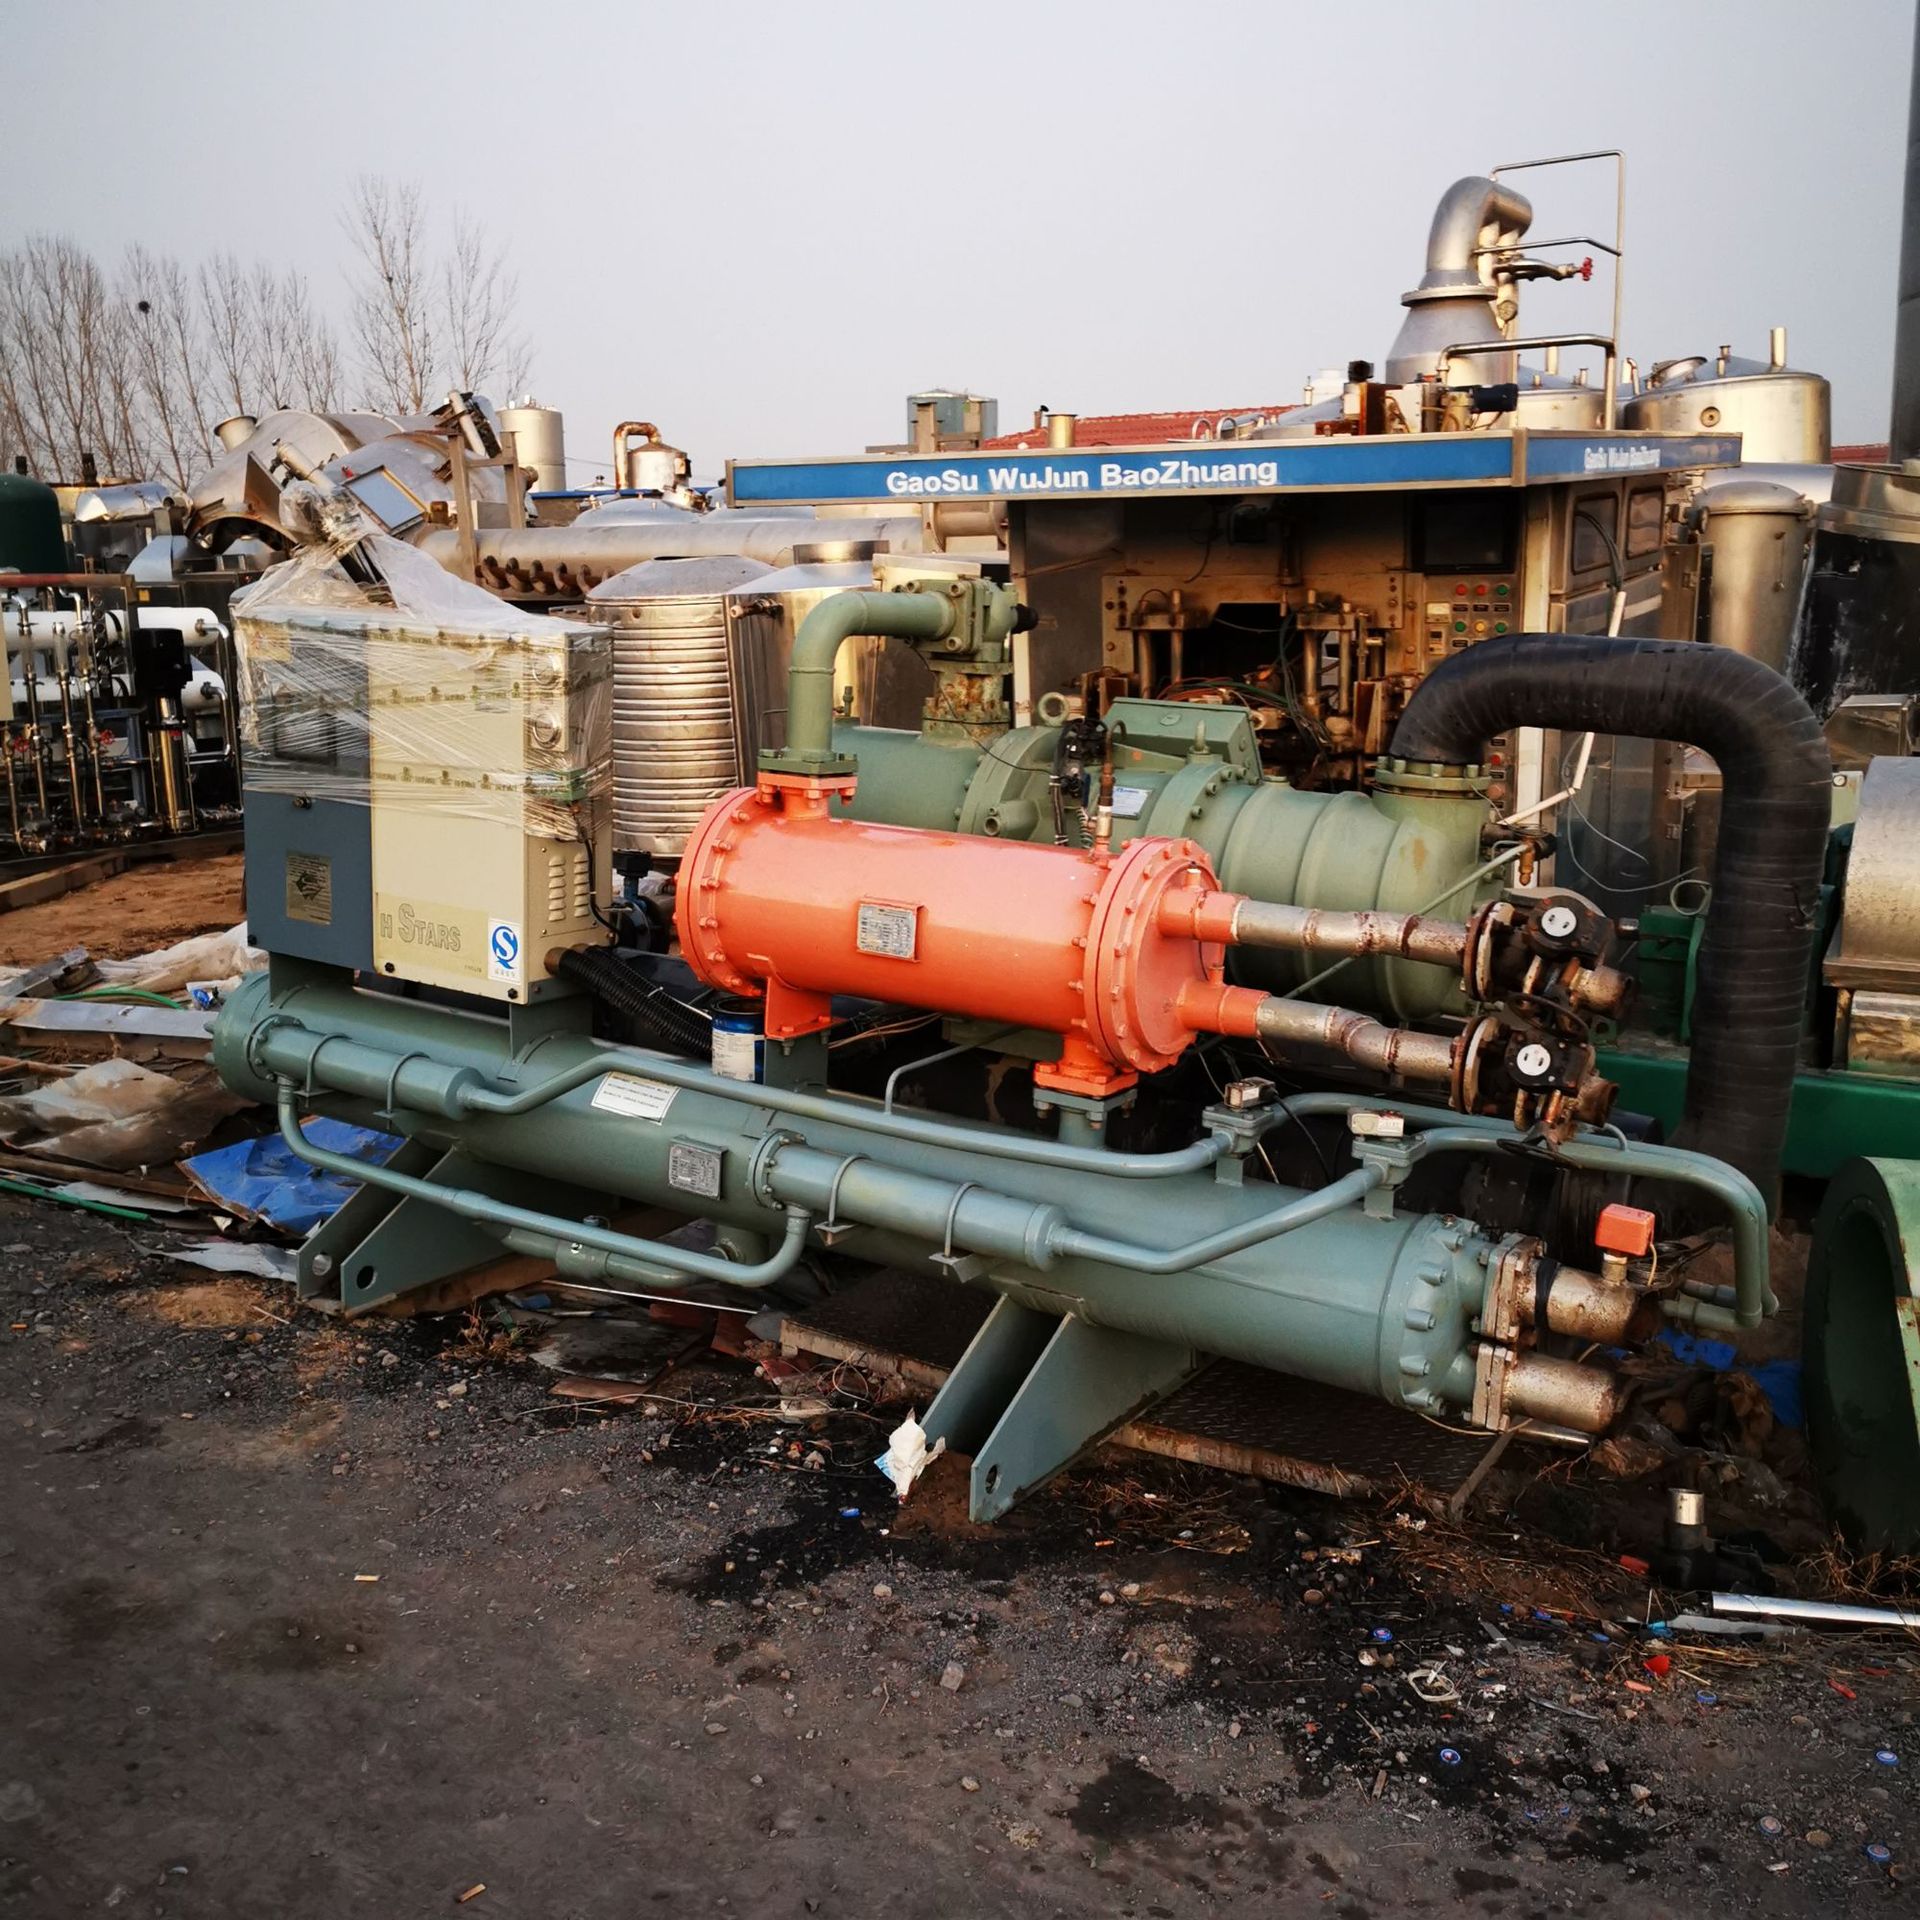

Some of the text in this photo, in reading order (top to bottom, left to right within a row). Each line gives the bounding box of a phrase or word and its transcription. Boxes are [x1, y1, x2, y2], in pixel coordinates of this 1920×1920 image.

[886, 460, 1278, 493] GaoSu WuJun BaoZhuang
[398, 902, 461, 952] STARS
